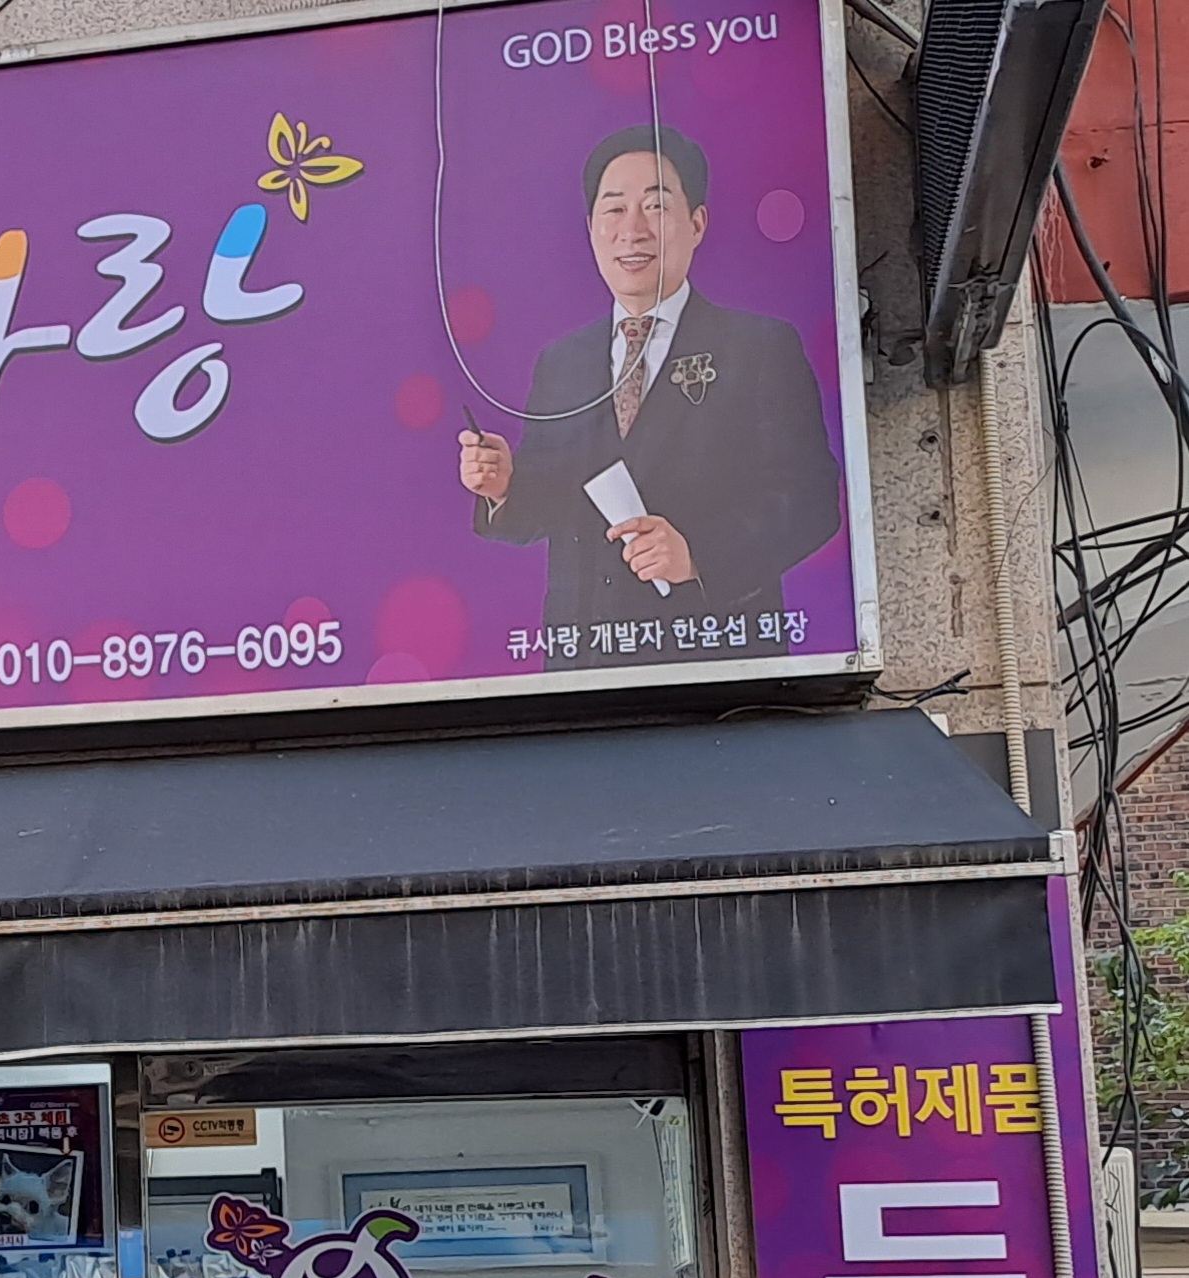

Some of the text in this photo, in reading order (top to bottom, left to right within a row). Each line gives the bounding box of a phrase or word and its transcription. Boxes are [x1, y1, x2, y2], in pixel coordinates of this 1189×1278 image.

[503, 13, 778, 68] GOD Bless you
[506, 609, 809, 660] 큐사랑 개발자 한윤섭 회장
[774, 1063, 1044, 1140] 특허제품
